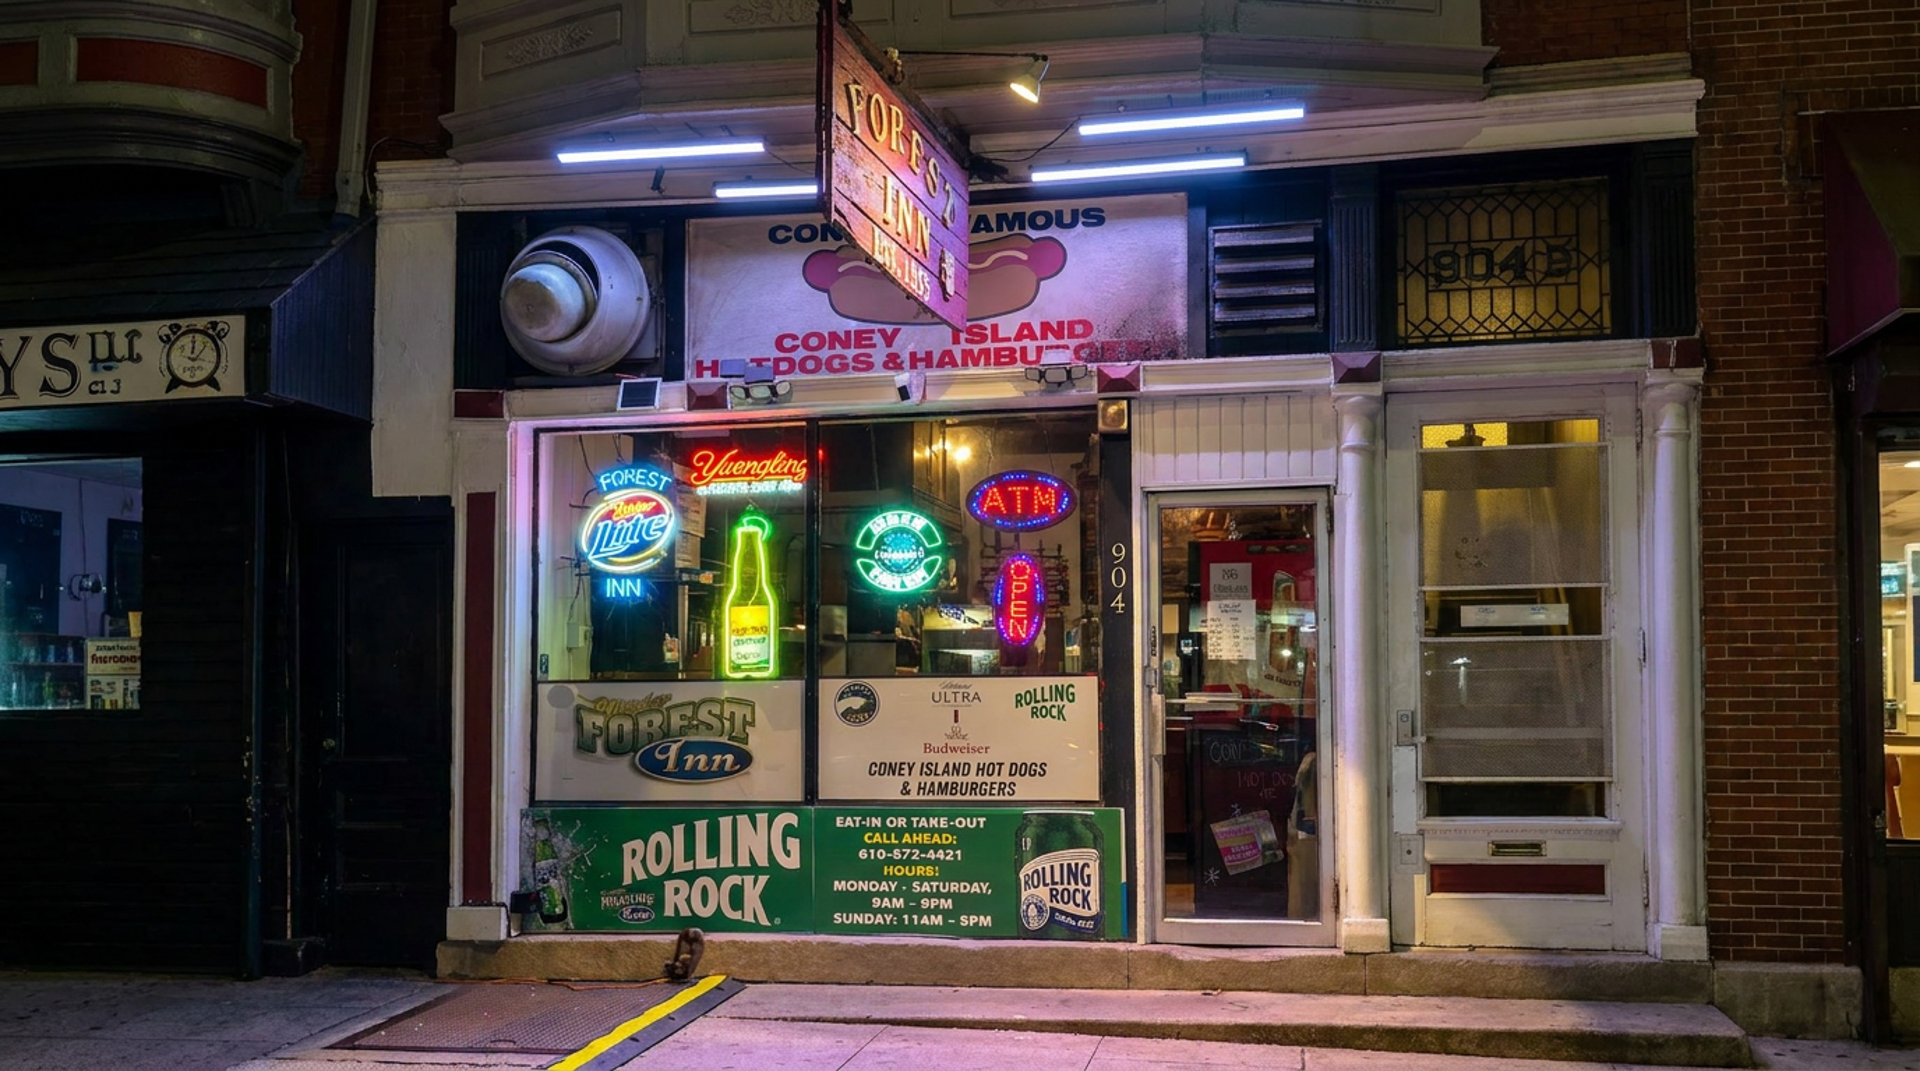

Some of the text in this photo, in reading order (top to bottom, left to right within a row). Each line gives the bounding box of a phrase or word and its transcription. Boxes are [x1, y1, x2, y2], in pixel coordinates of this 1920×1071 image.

[882, 174, 931, 259] INN
[968, 208, 1105, 233] AMOUS
[774, 319, 1094, 354] CONEY ISLAND
[882, 352, 904, 371] &
[691, 449, 807, 484] Yuengling
[599, 468, 672, 491] FOREST
[983, 486, 1056, 514] ATM
[606, 578, 641, 597] INN
[1110, 543, 1127, 614] 904
[1010, 560, 1030, 638] OPEN
[931, 692, 982, 703] ULTRA
[1015, 683, 1076, 709] ROLLING
[1030, 704, 1067, 721] ROCK
[576, 697, 756, 755] FOREST
[654, 739, 741, 772] Inn
[923, 742, 990, 754] Budweiser
[868, 762, 1047, 777] CONEY ISLAND HOT DOGS
[900, 781, 1016, 797] & HAMBURGERS
[836, 817, 881, 828] EAT-IN
[886, 817, 907, 828] OR
[622, 812, 800, 886] ROLLING
[864, 833, 957, 844] CALL AHEAD:
[833, 881, 898, 892] MONDAY
[912, 881, 992, 895] SATURDAY,
[1023, 862, 1092, 891] ROLLING
[663, 875, 771, 926] ROCK
[872, 897, 904, 908] 9AM
[1049, 888, 1092, 911] ROCK
[833, 913, 898, 924] SUNDAY:
[902, 914, 943, 926] 11AM
